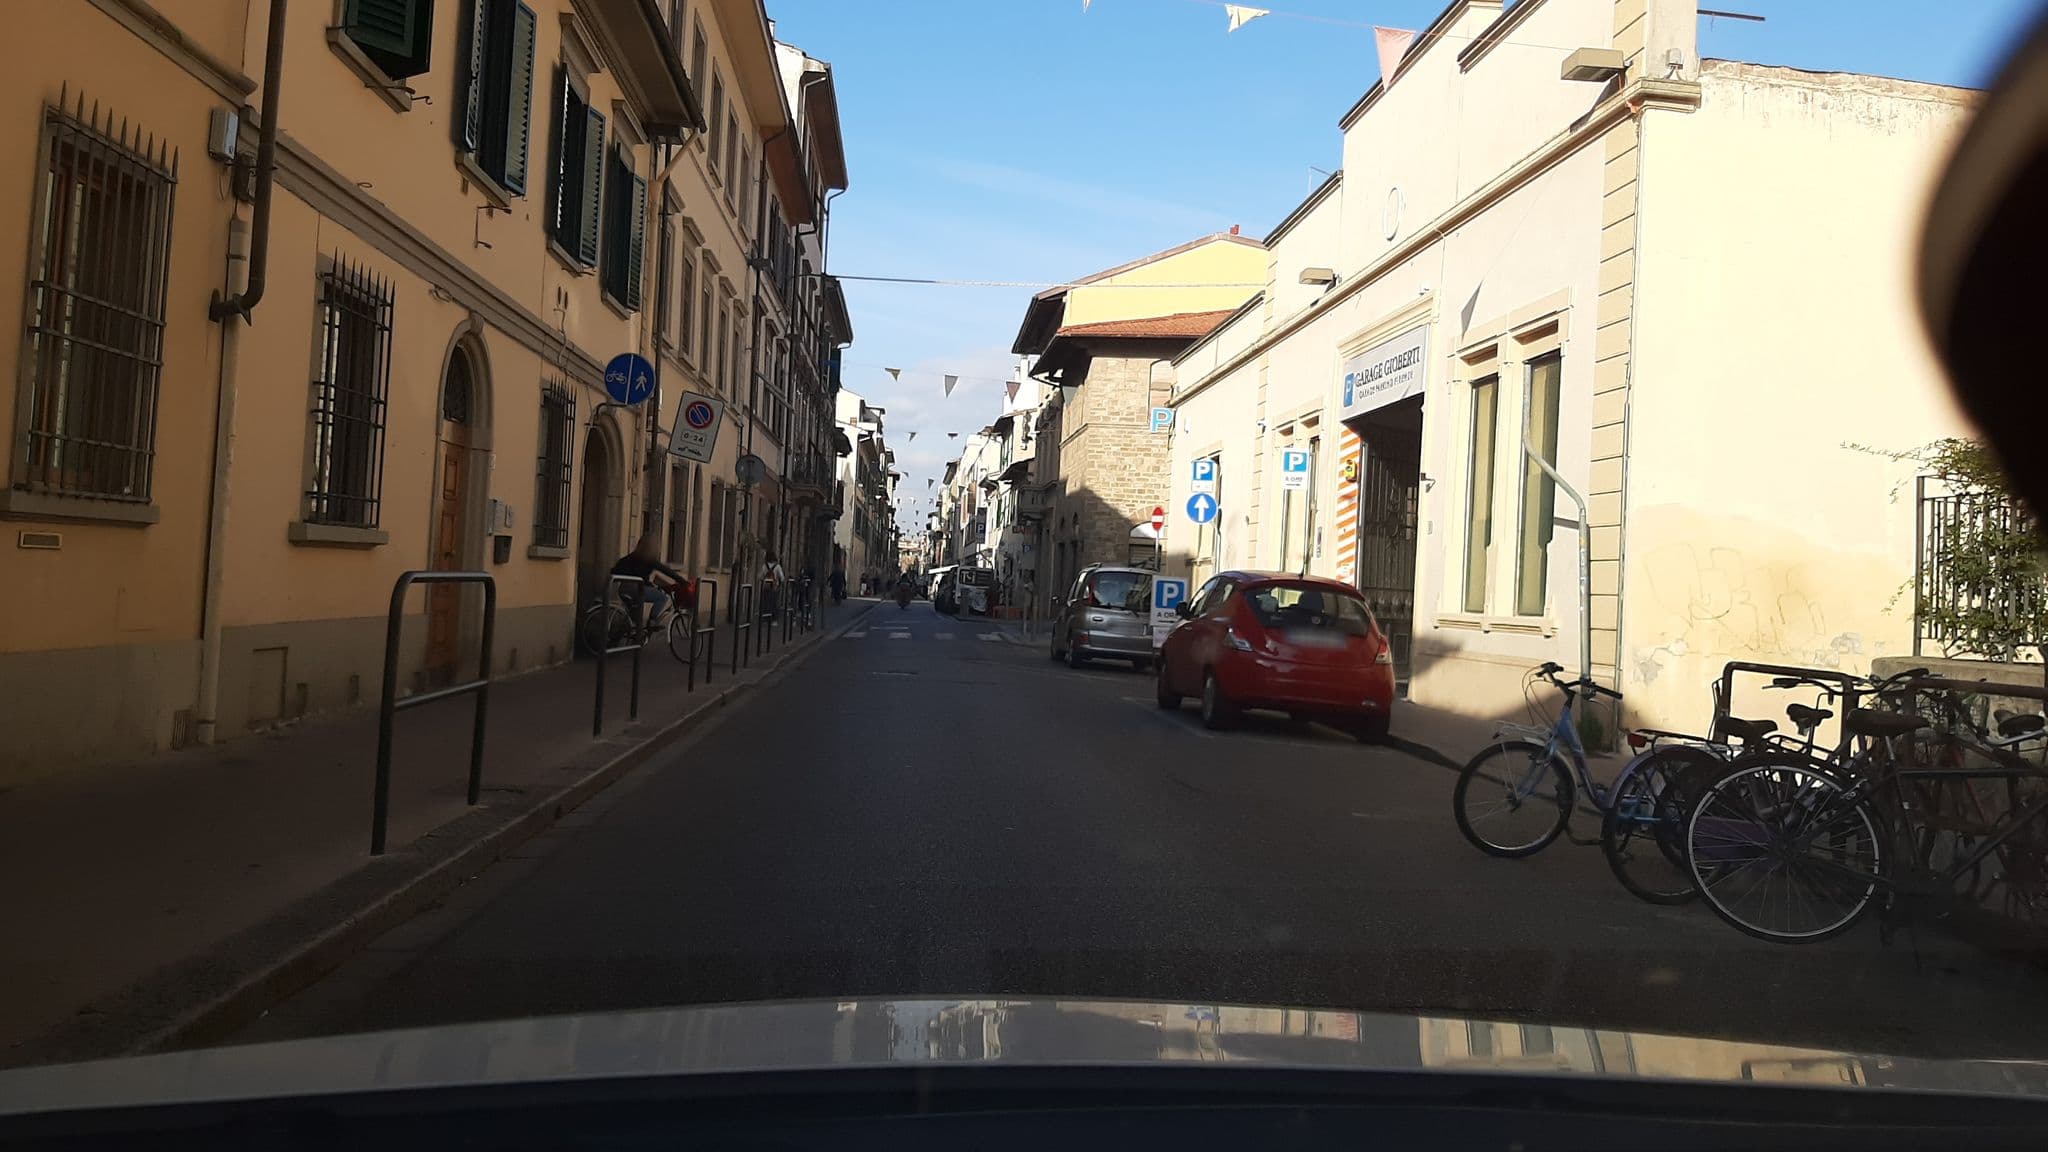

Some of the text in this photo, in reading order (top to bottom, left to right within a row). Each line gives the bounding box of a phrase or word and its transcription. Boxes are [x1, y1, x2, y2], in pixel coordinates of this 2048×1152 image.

[1355, 346, 1420, 387] GARAGE GIOBERTI
[1151, 408, 1173, 432] P
[1196, 461, 1211, 480] P
[1289, 453, 1304, 471] P
[1162, 582, 1179, 607] P
